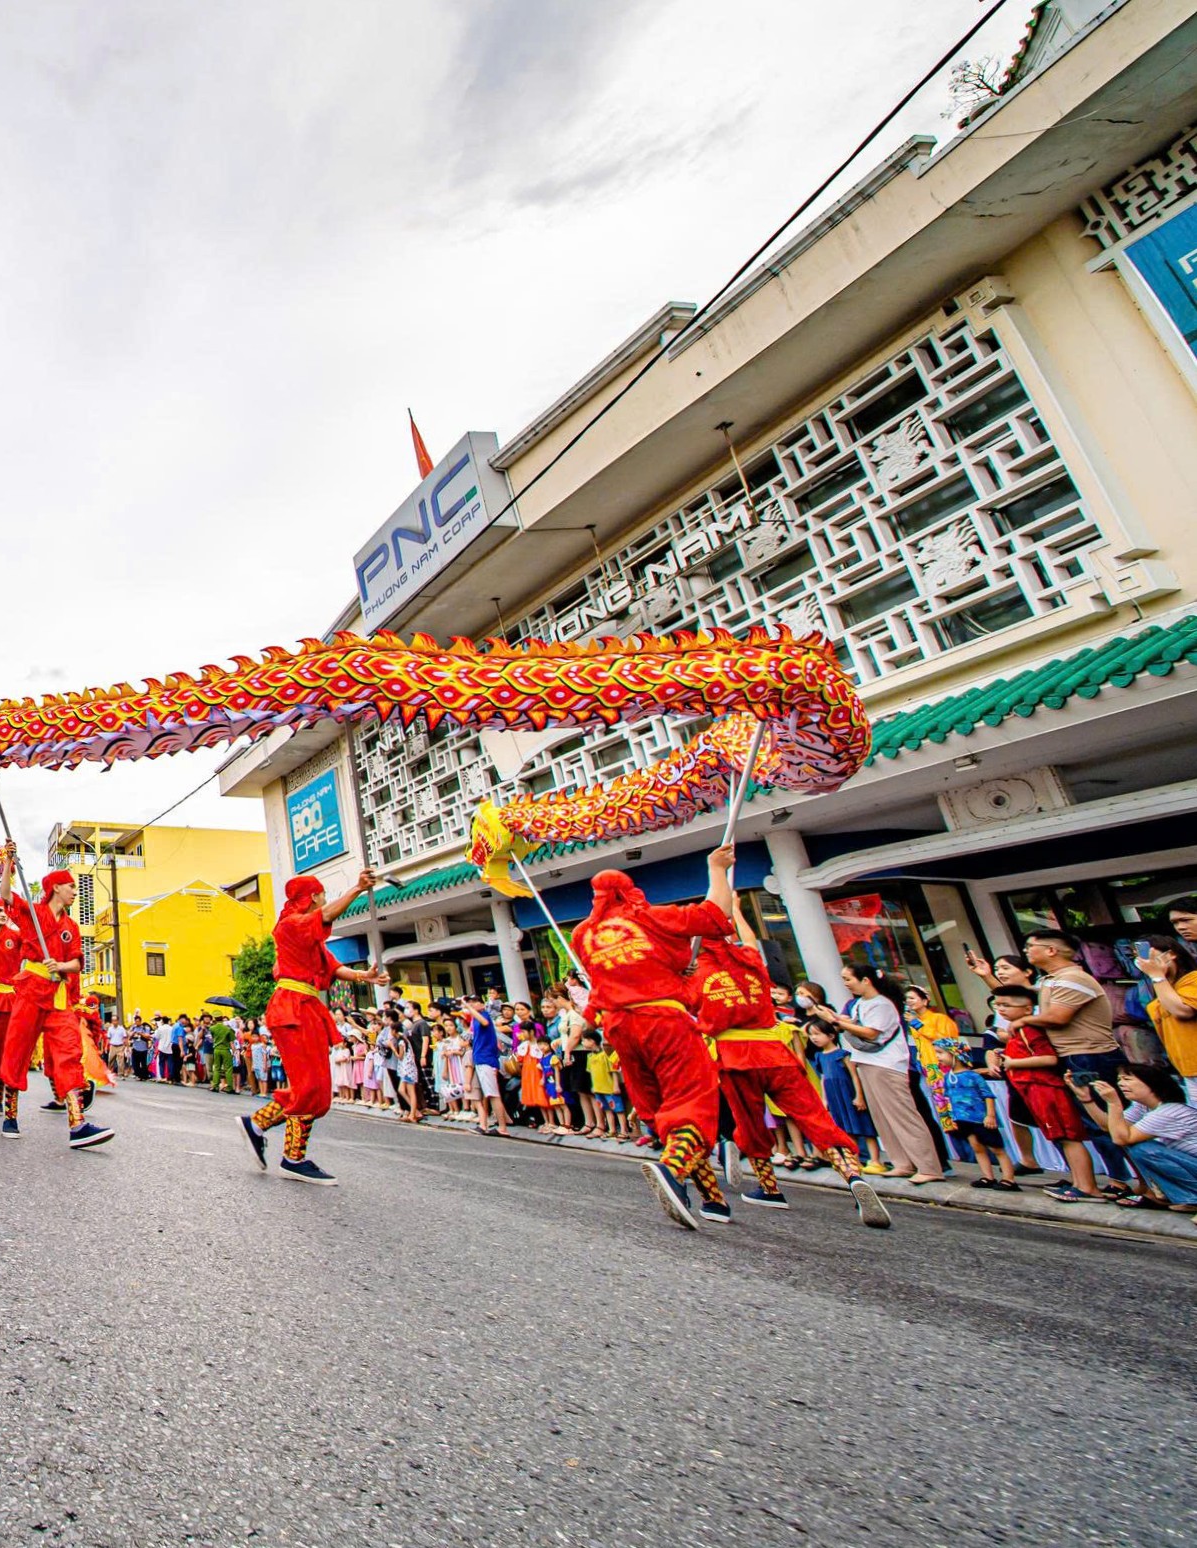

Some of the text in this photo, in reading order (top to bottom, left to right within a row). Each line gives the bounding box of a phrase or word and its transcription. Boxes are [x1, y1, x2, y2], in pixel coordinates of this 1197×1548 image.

[356, 453, 478, 603] PNC
[411, 542, 439, 576] NAM
[442, 501, 481, 545] CORP
[644, 503, 753, 590] NAM
[295, 823, 340, 861] CAFE
